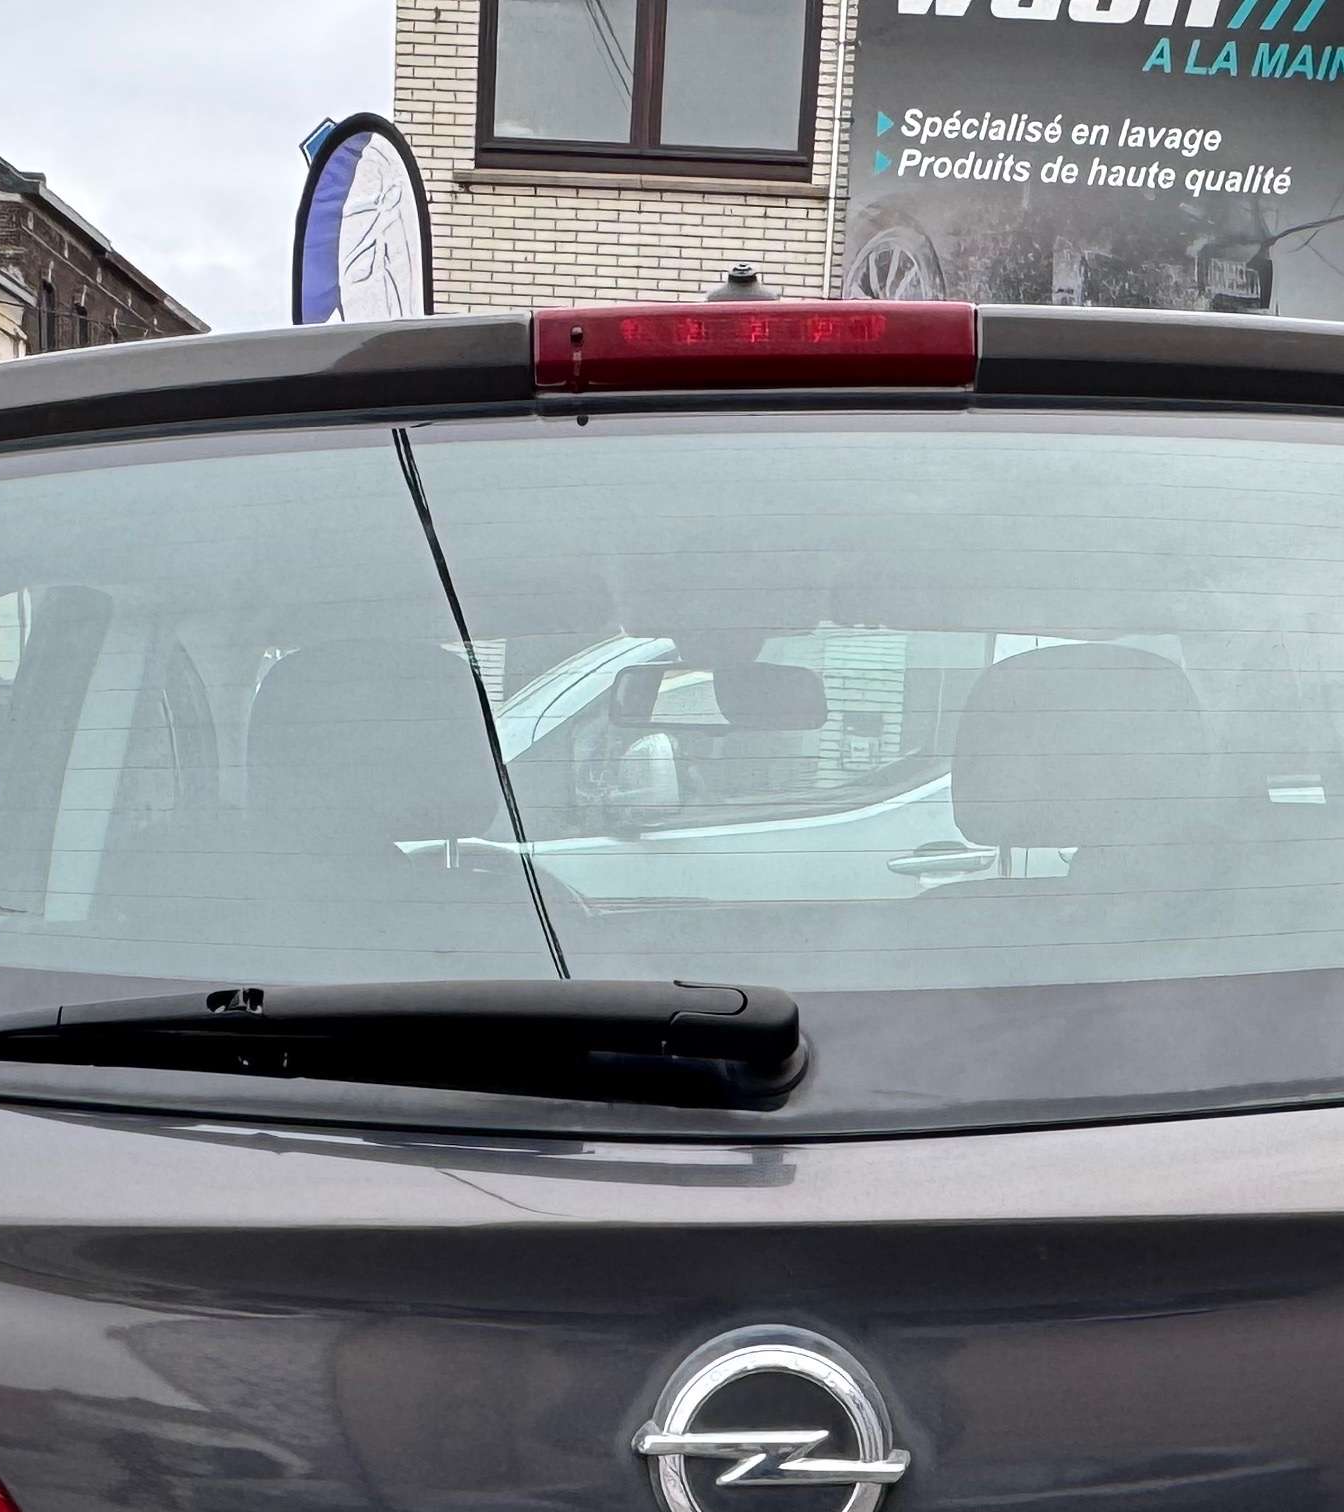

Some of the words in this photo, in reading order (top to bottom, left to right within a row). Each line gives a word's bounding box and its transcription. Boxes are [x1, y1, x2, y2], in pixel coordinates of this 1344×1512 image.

[1142, 37, 1172, 74] A
[1184, 39, 1238, 77] LA
[900, 108, 1062, 144] Spécialisé
[1071, 122, 1109, 146] en
[1117, 118, 1223, 158] lavage
[897, 149, 1032, 182] Produits
[1039, 155, 1078, 184] de
[1086, 158, 1176, 190] haute
[1184, 165, 1292, 198] qualité
